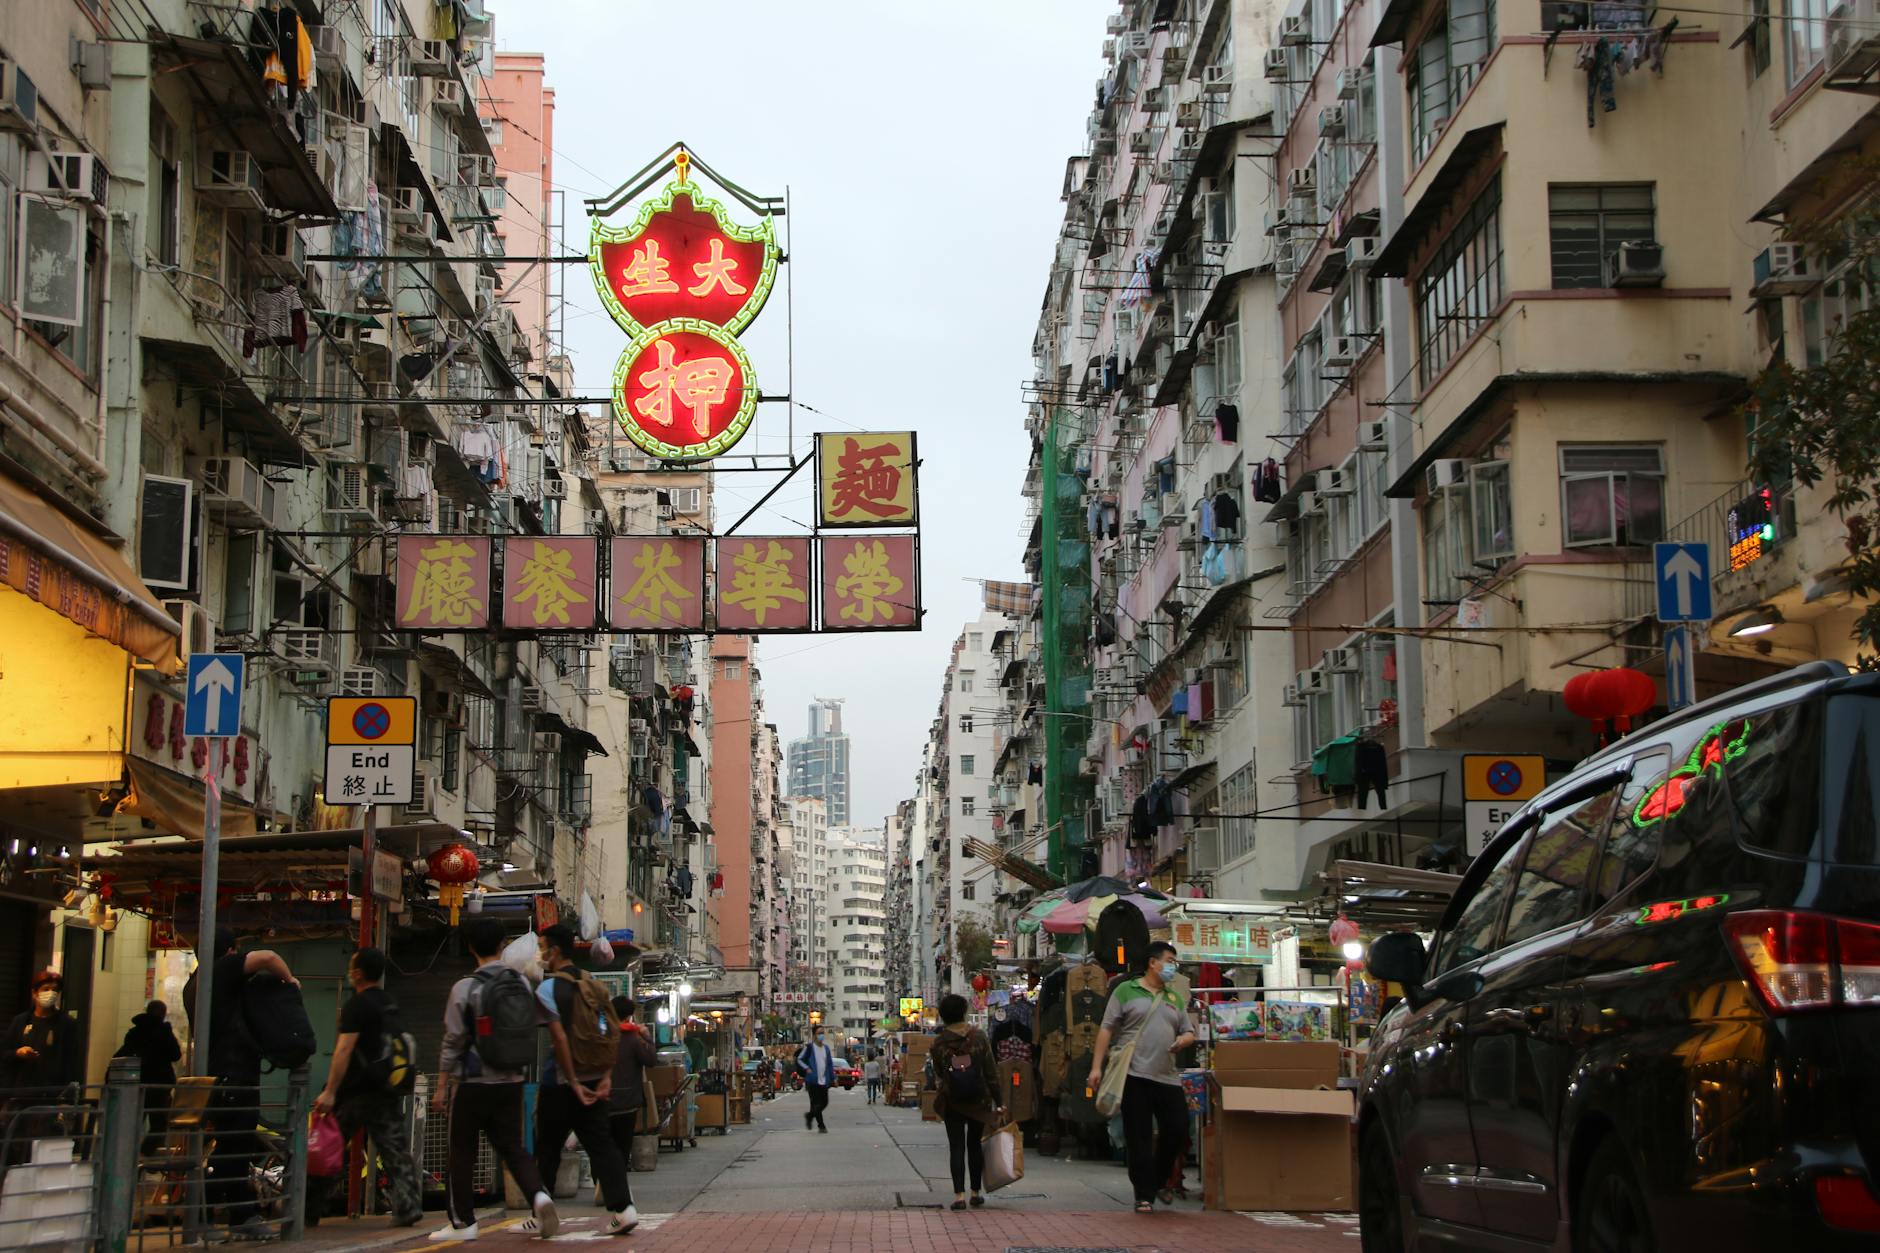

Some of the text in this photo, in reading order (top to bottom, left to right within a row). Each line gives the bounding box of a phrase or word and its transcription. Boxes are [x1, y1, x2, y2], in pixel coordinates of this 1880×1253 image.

[634, 339, 735, 438] 押
[351, 752, 389, 768] End
[343, 775, 396, 797] 終止
[1488, 808, 1511, 823] En
[1175, 923, 1270, 949] 電話咭
